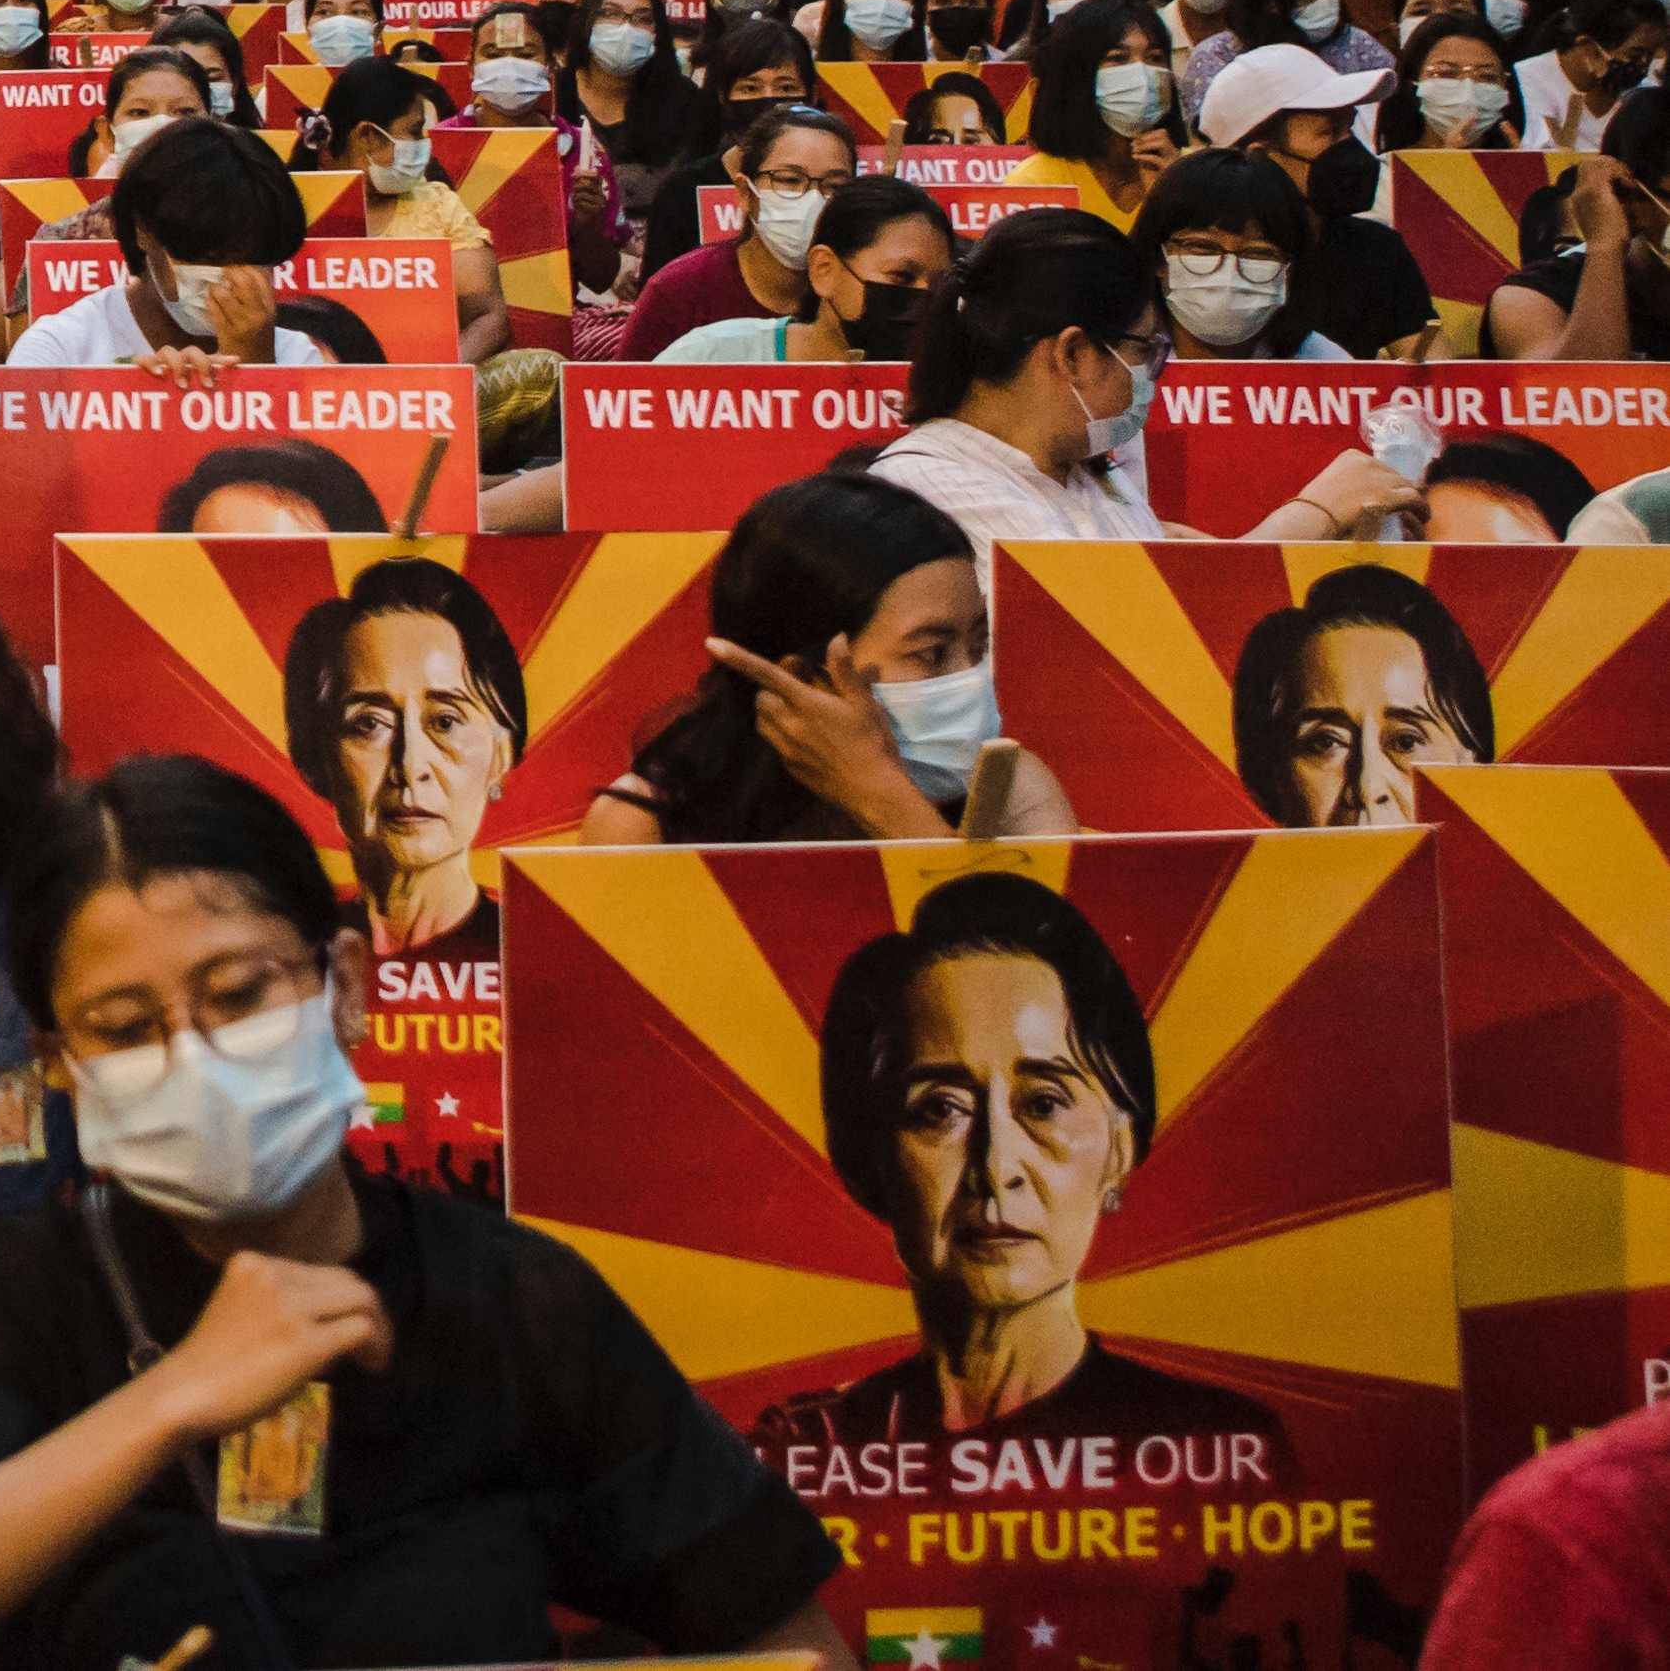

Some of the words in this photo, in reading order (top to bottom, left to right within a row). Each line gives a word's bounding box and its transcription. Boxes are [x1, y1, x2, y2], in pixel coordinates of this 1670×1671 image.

[3, 83, 73, 107] WANT
[79, 83, 106, 106] OU
[44, 259, 100, 293] WE
[306, 256, 440, 291] LEADER
[39, 390, 169, 431] WANT
[179, 390, 276, 433] OUR
[286, 389, 458, 433] LEADER
[583, 388, 654, 429] WE
[665, 388, 801, 429] WANT
[1160, 385, 1232, 425] WE
[1243, 385, 1380, 427] WANT
[1500, 387, 1670, 428] LEADER
[377, 960, 501, 1001] SAVE
[950, 1435, 1116, 1495] SAVE
[1134, 1432, 1270, 1487] OUR
[907, 1506, 1162, 1566] FUTURE
[1200, 1498, 1374, 1558] HOPE
